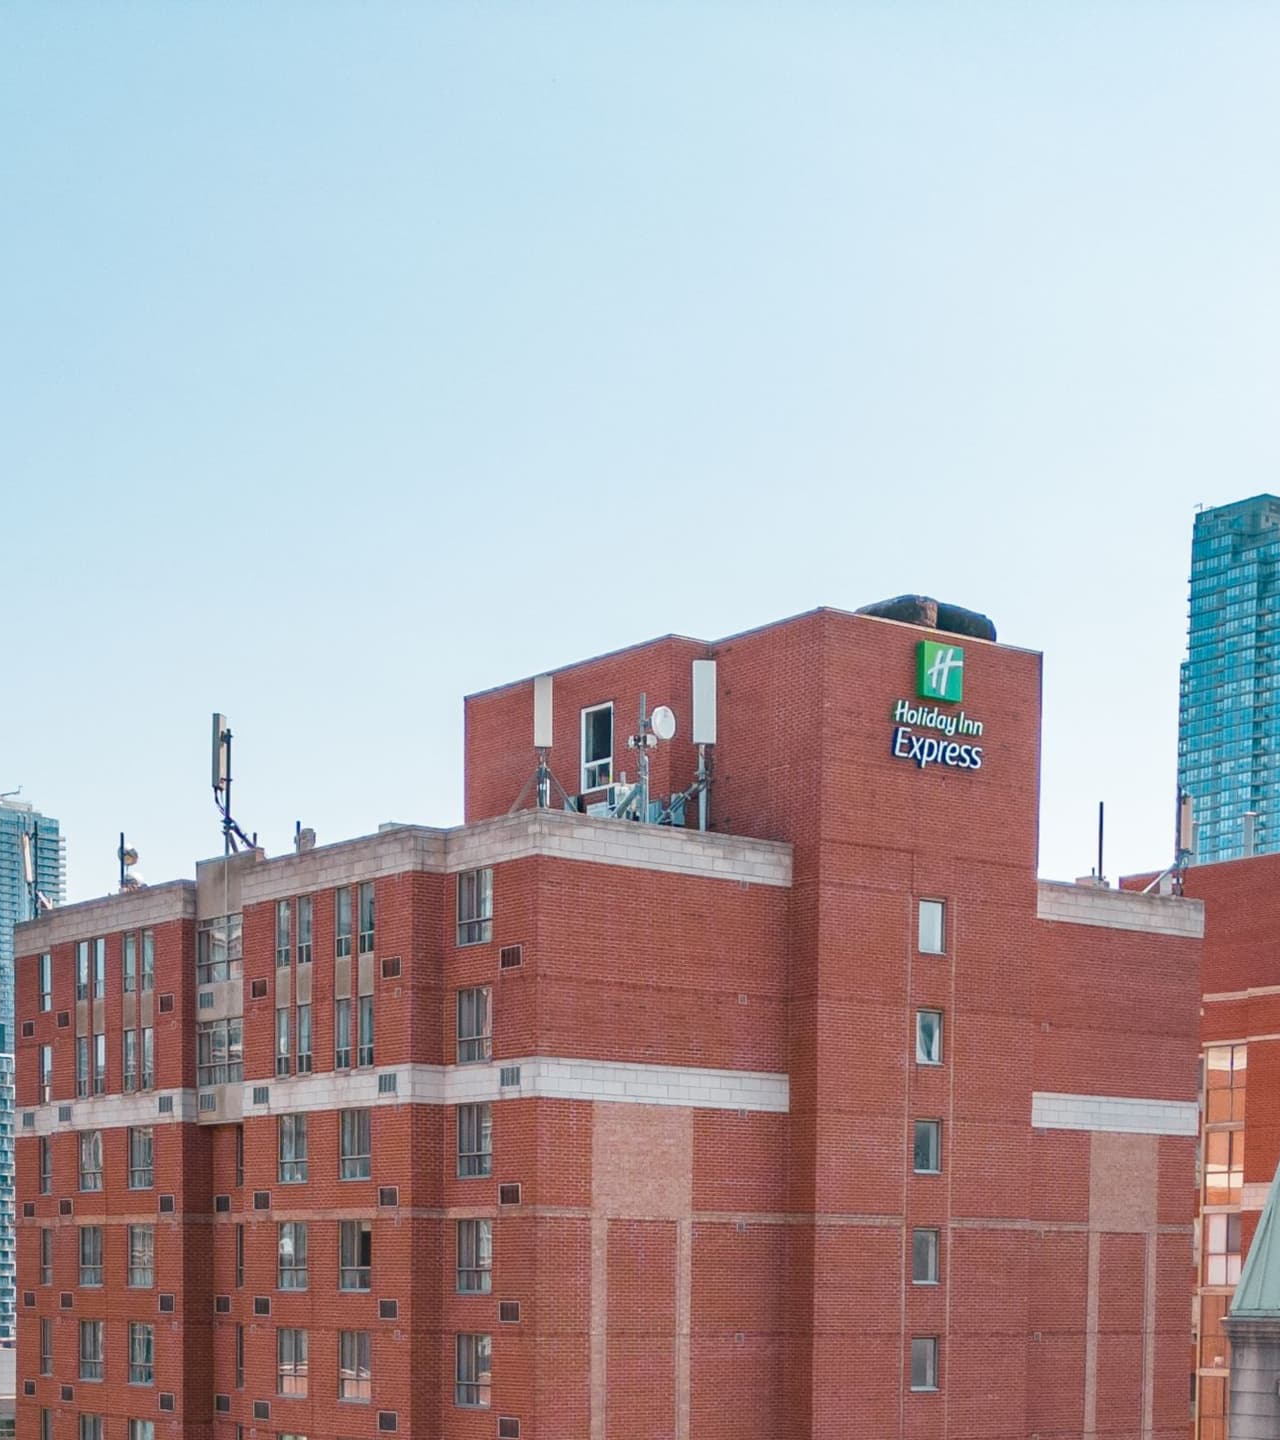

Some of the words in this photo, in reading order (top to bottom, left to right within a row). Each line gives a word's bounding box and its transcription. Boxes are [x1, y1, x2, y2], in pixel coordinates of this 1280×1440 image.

[895, 699, 957, 736] Holiday
[958, 711, 983, 737] Inn
[894, 727, 983, 769] Express
